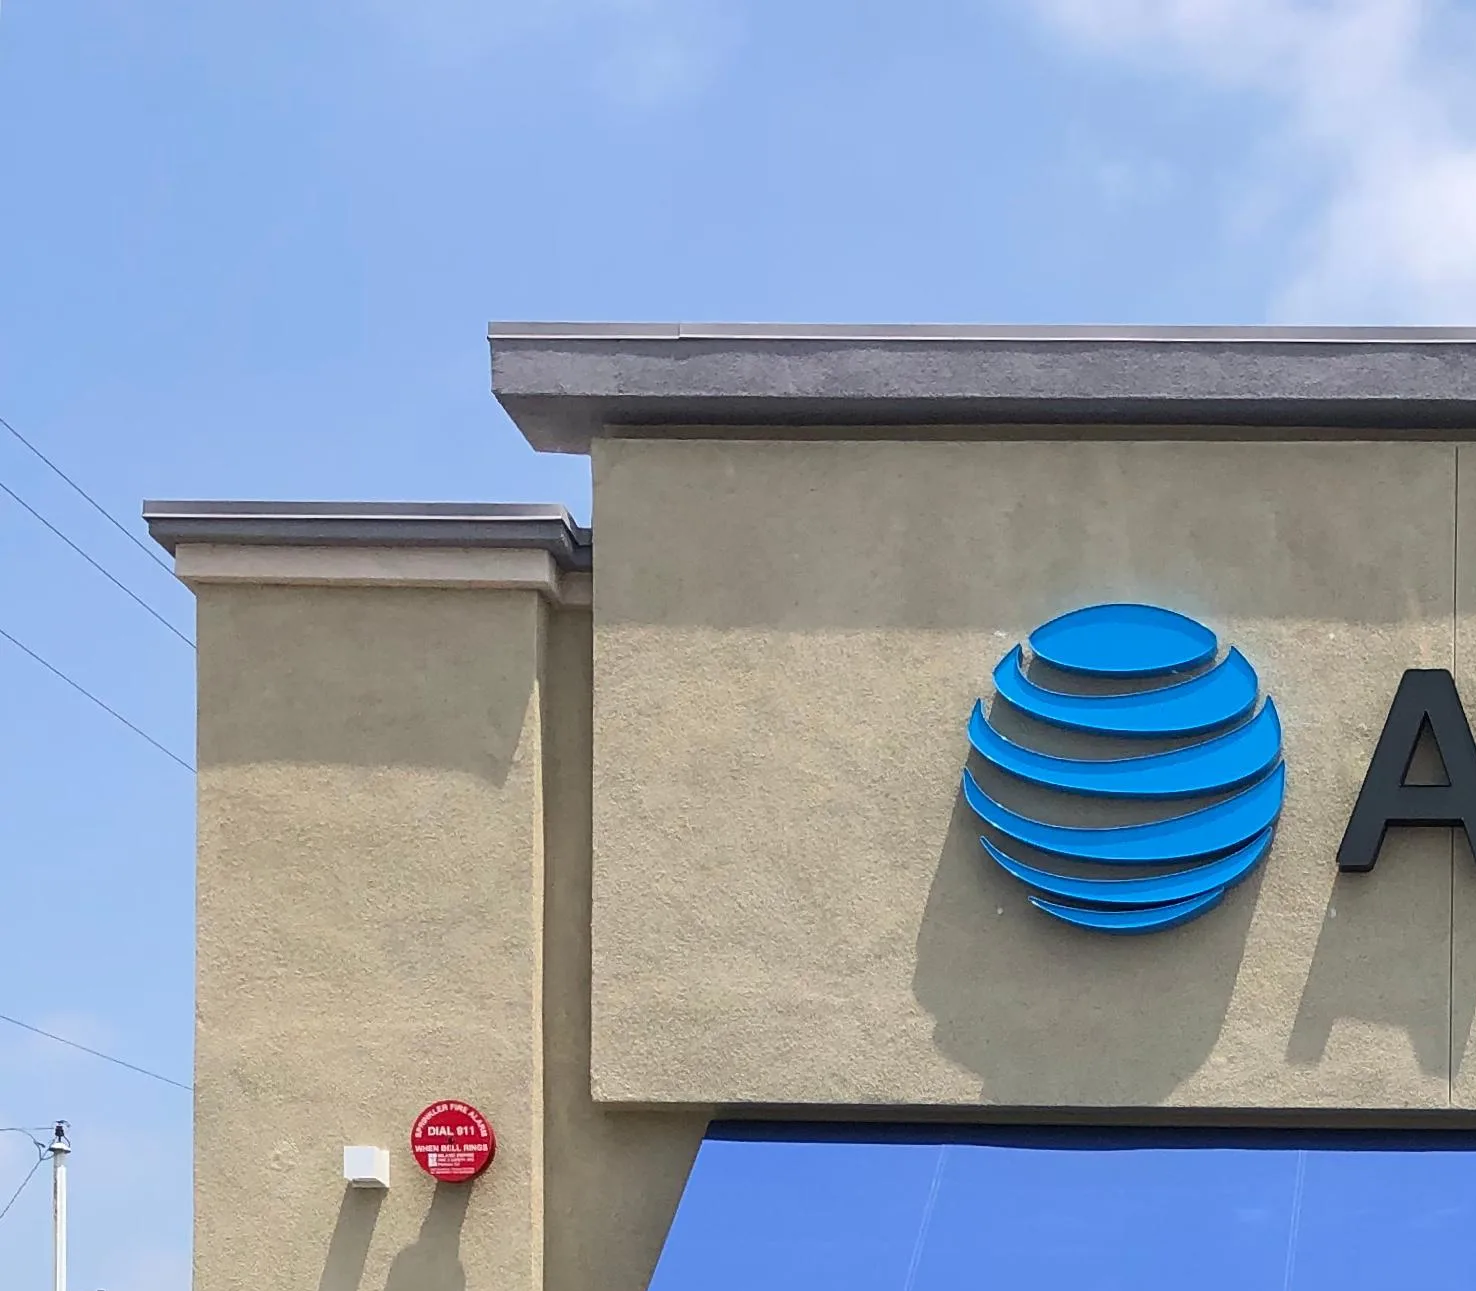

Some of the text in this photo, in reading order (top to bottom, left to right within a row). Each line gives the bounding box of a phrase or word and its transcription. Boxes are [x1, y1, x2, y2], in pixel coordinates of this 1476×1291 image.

[449, 1103, 468, 1114] FIRE
[427, 1126, 475, 1136] DIAL 911
[414, 1144, 488, 1152] WHEN BELL RINGS
